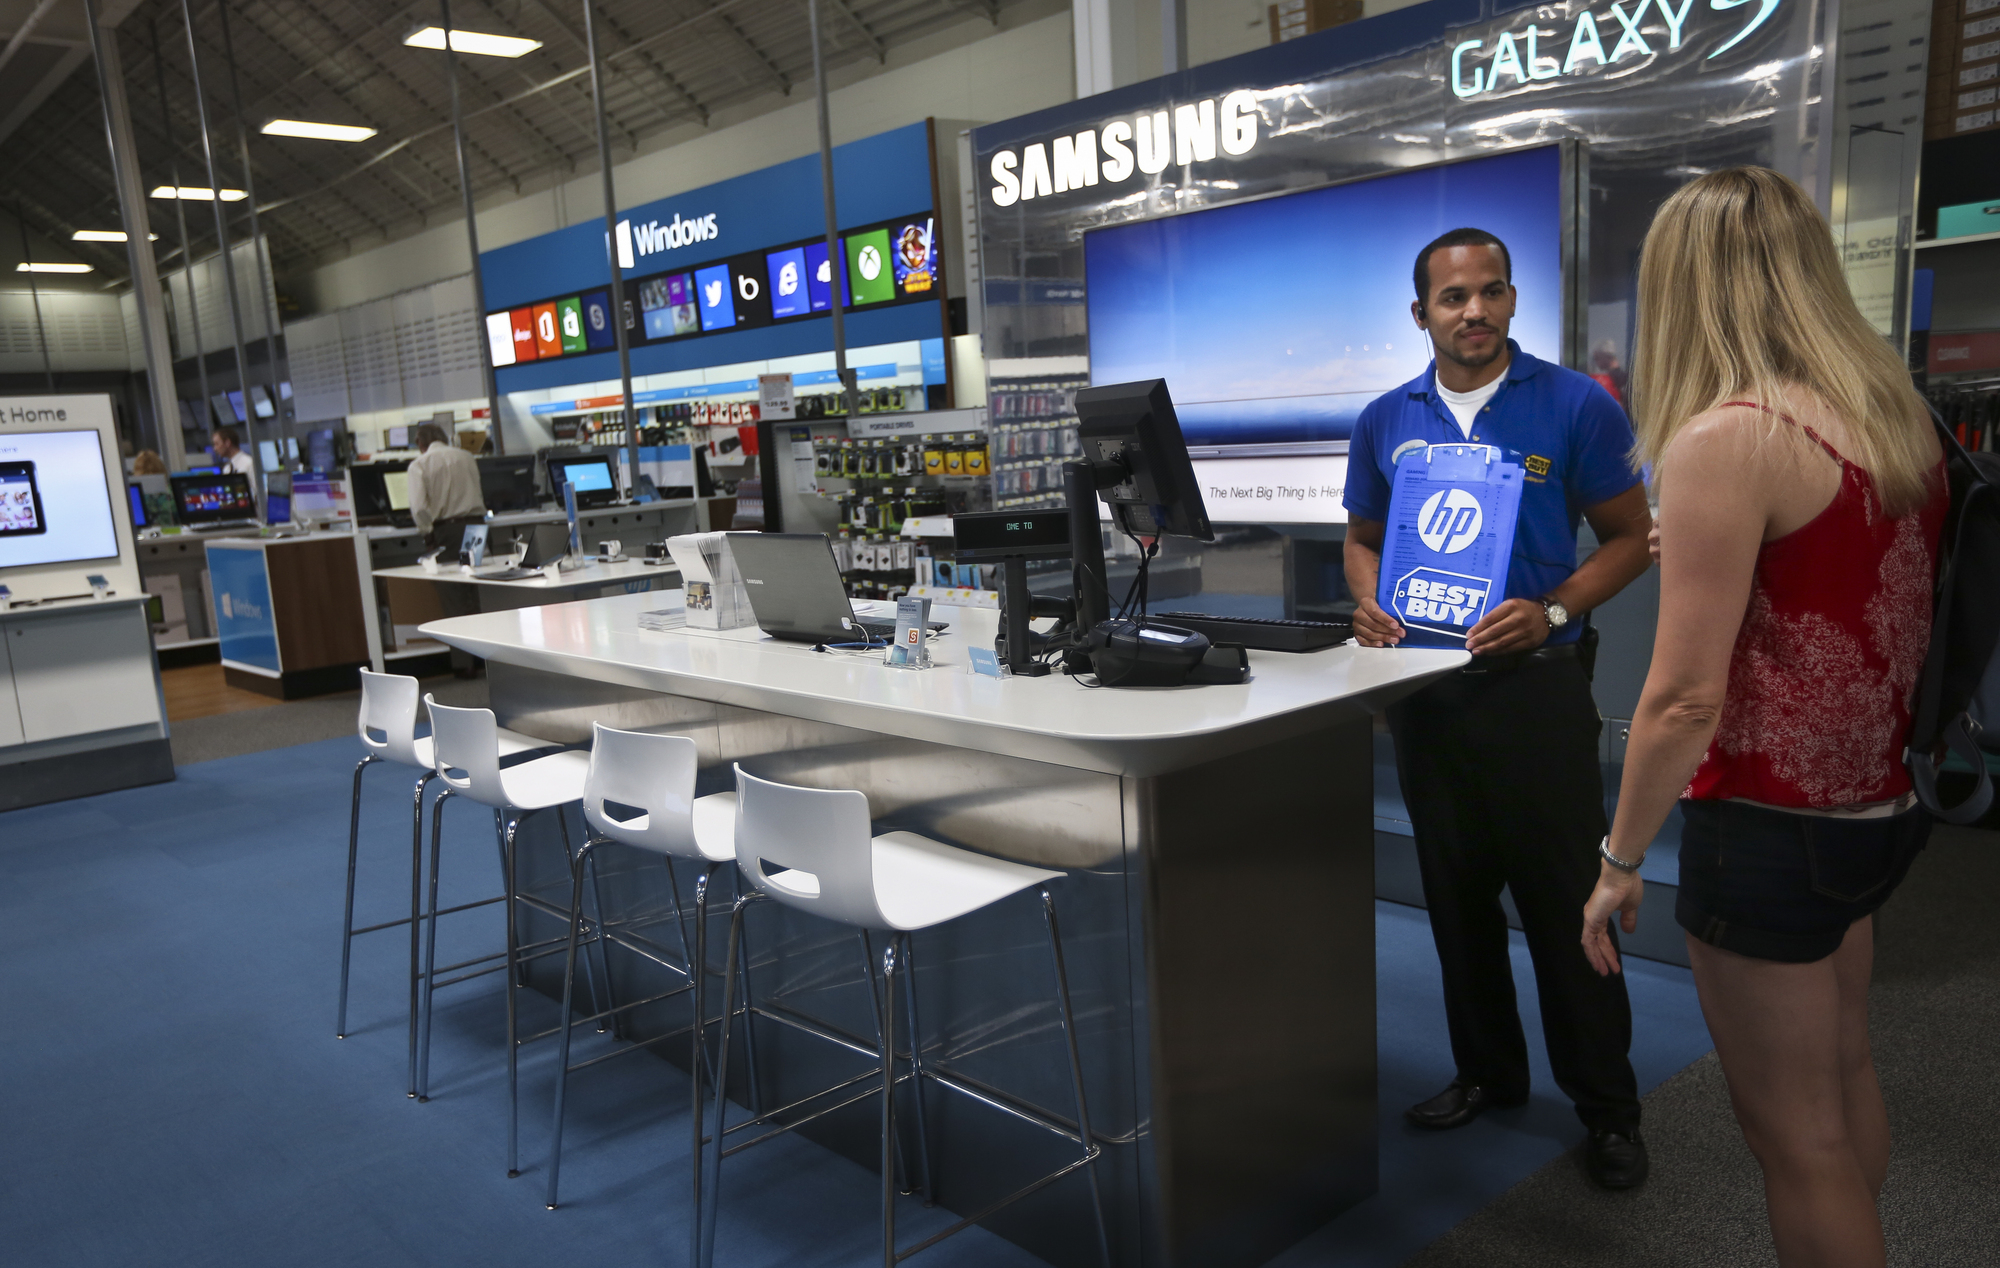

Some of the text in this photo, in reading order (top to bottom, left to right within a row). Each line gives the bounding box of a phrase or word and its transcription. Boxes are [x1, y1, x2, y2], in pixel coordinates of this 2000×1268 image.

[1450, 0, 1693, 98] GALAXY
[990, 89, 1258, 207] SAMSUNG
[633, 212, 719, 257] Windows
[10, 406, 67, 423] Home
[869, 420, 914, 431] PORTABLE DRIVES
[1528, 463, 1546, 473] BUY
[1530, 457, 1549, 468] BEST
[1209, 485, 1345, 500] The Next Big Thing Is Here
[1023, 521, 1033, 530] TO
[1421, 488, 1480, 554] hp
[1406, 577, 1486, 609] BEST
[1405, 597, 1475, 626] BUY
[976, 658, 993, 666] SAMSUNG
